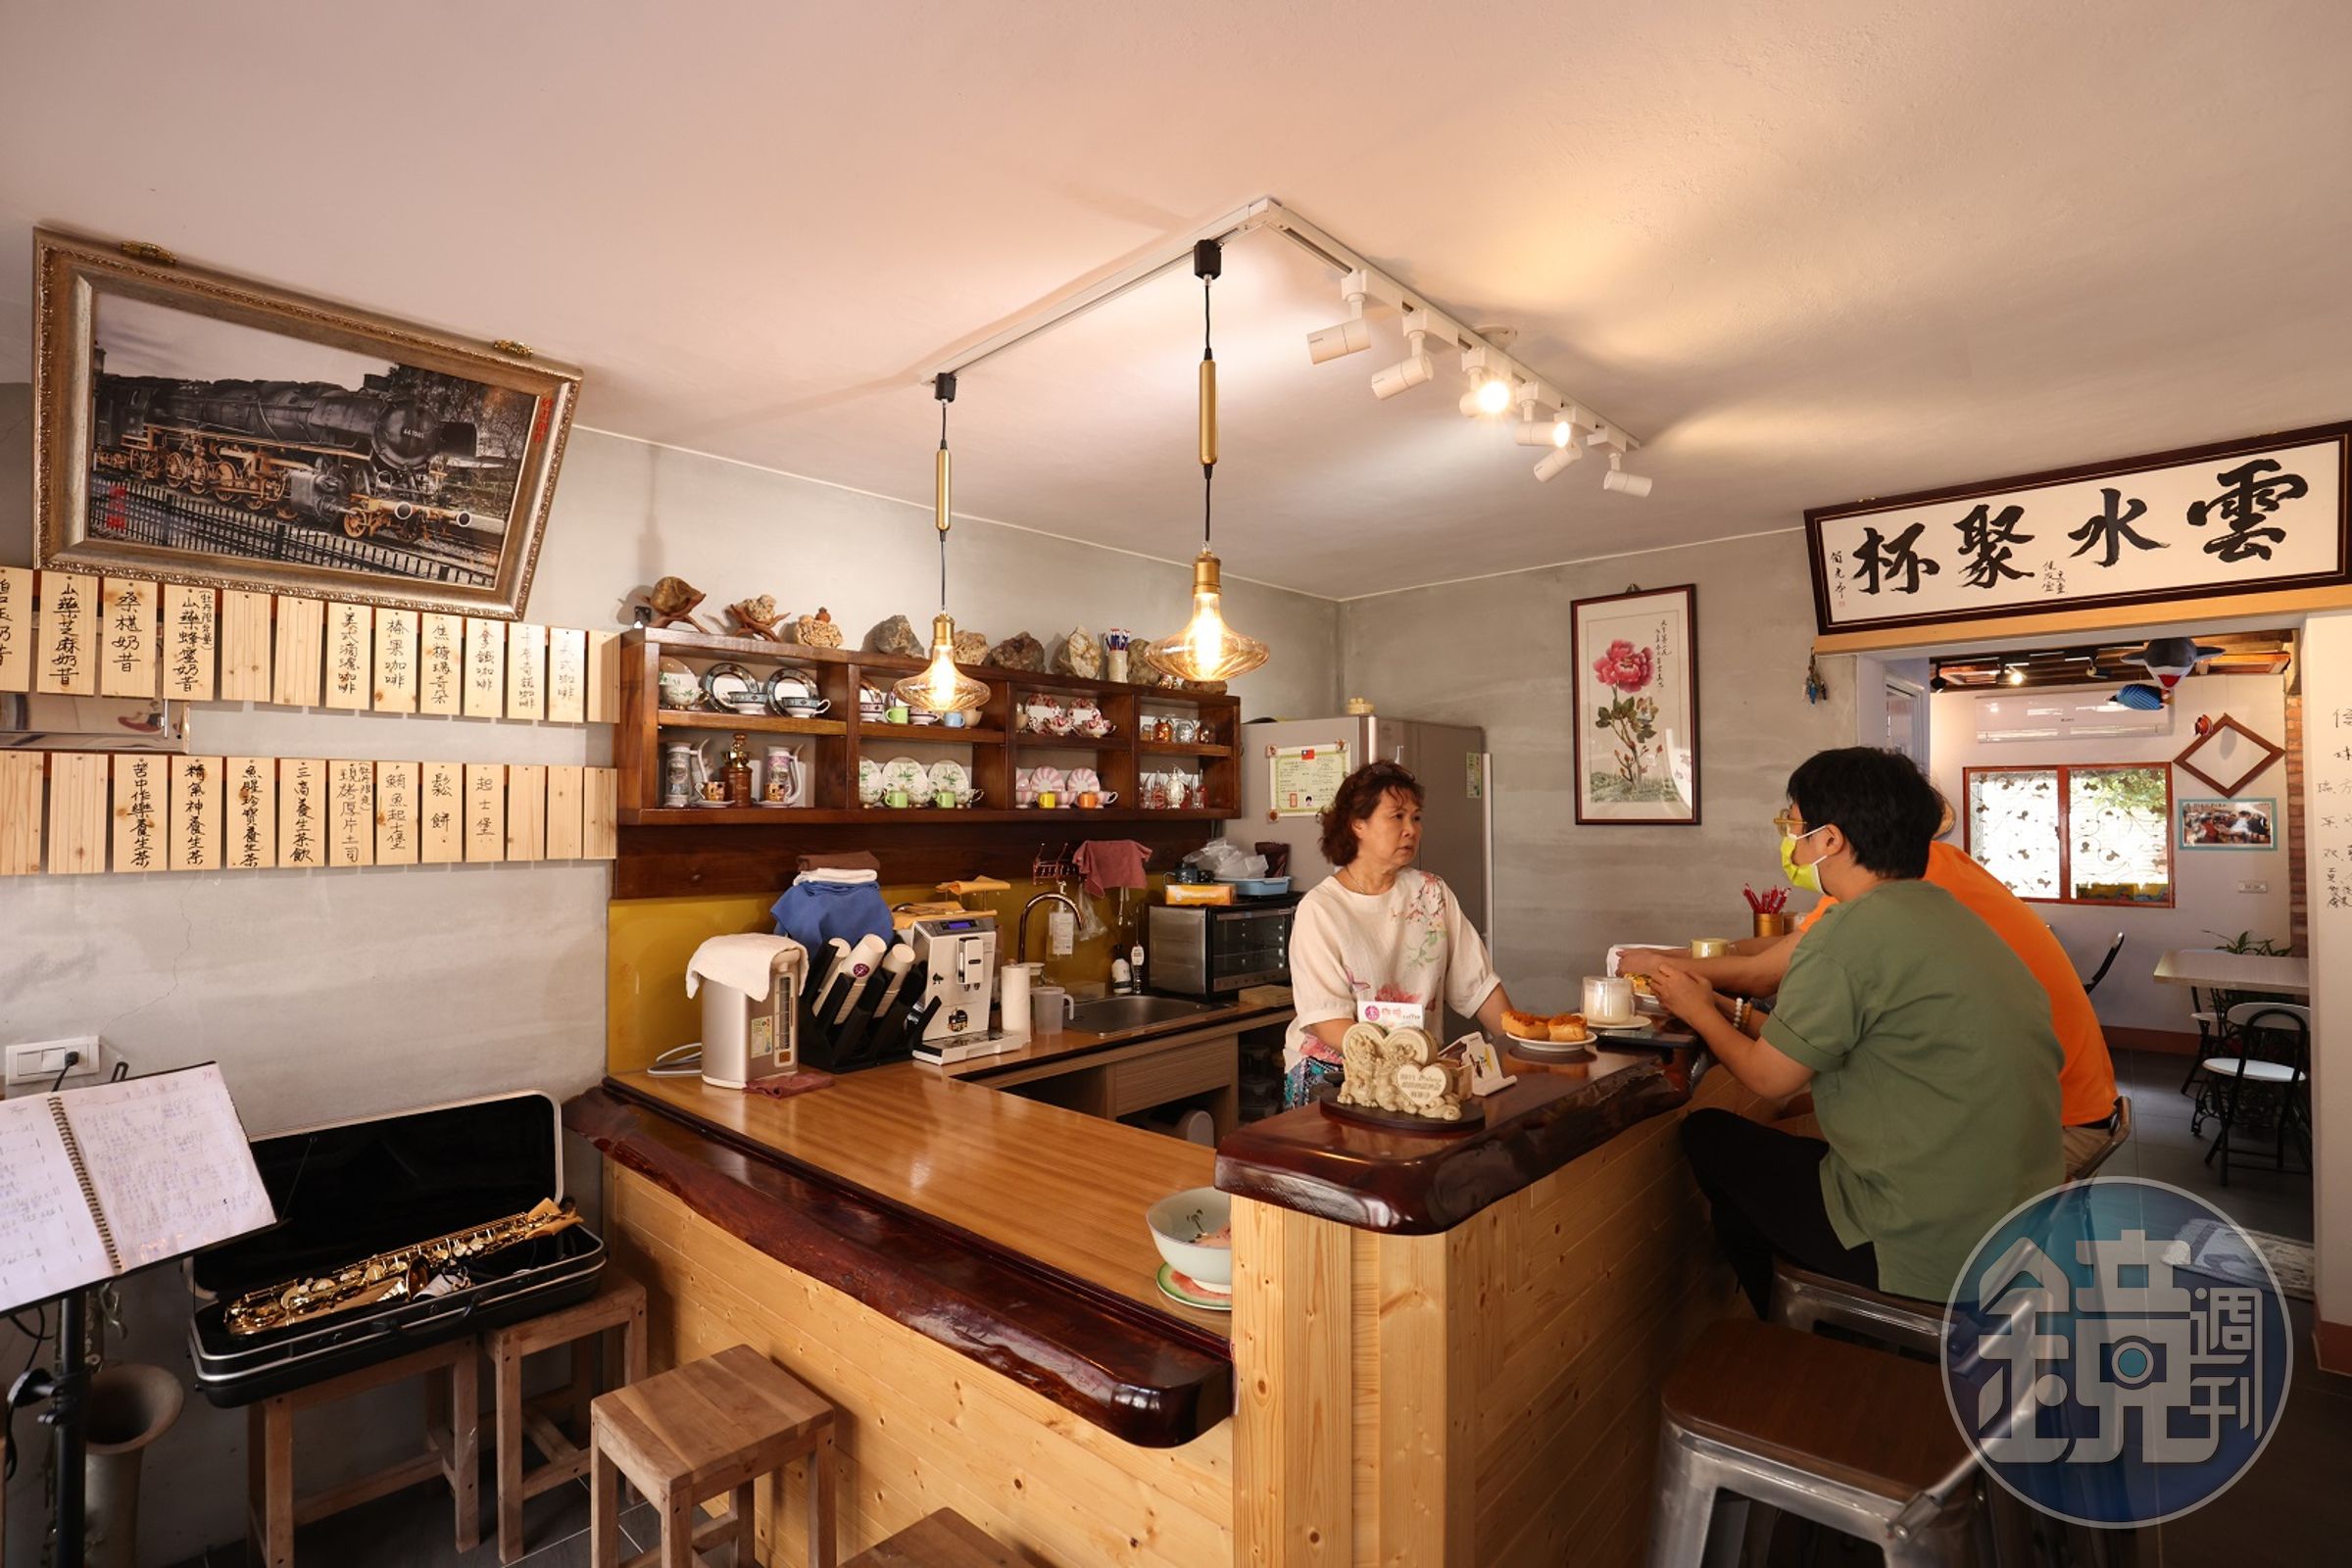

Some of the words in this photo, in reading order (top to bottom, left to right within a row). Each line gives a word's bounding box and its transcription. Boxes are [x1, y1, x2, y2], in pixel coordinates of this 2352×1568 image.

[49, 582, 80, 685] 山藥芝麻奶昔
[112, 591, 142, 672] 桑椹奶昔
[385, 618, 410, 689] 榛果咖啡
[430, 772, 453, 832] 鬆餅
[475, 776, 496, 836] 起士堡
